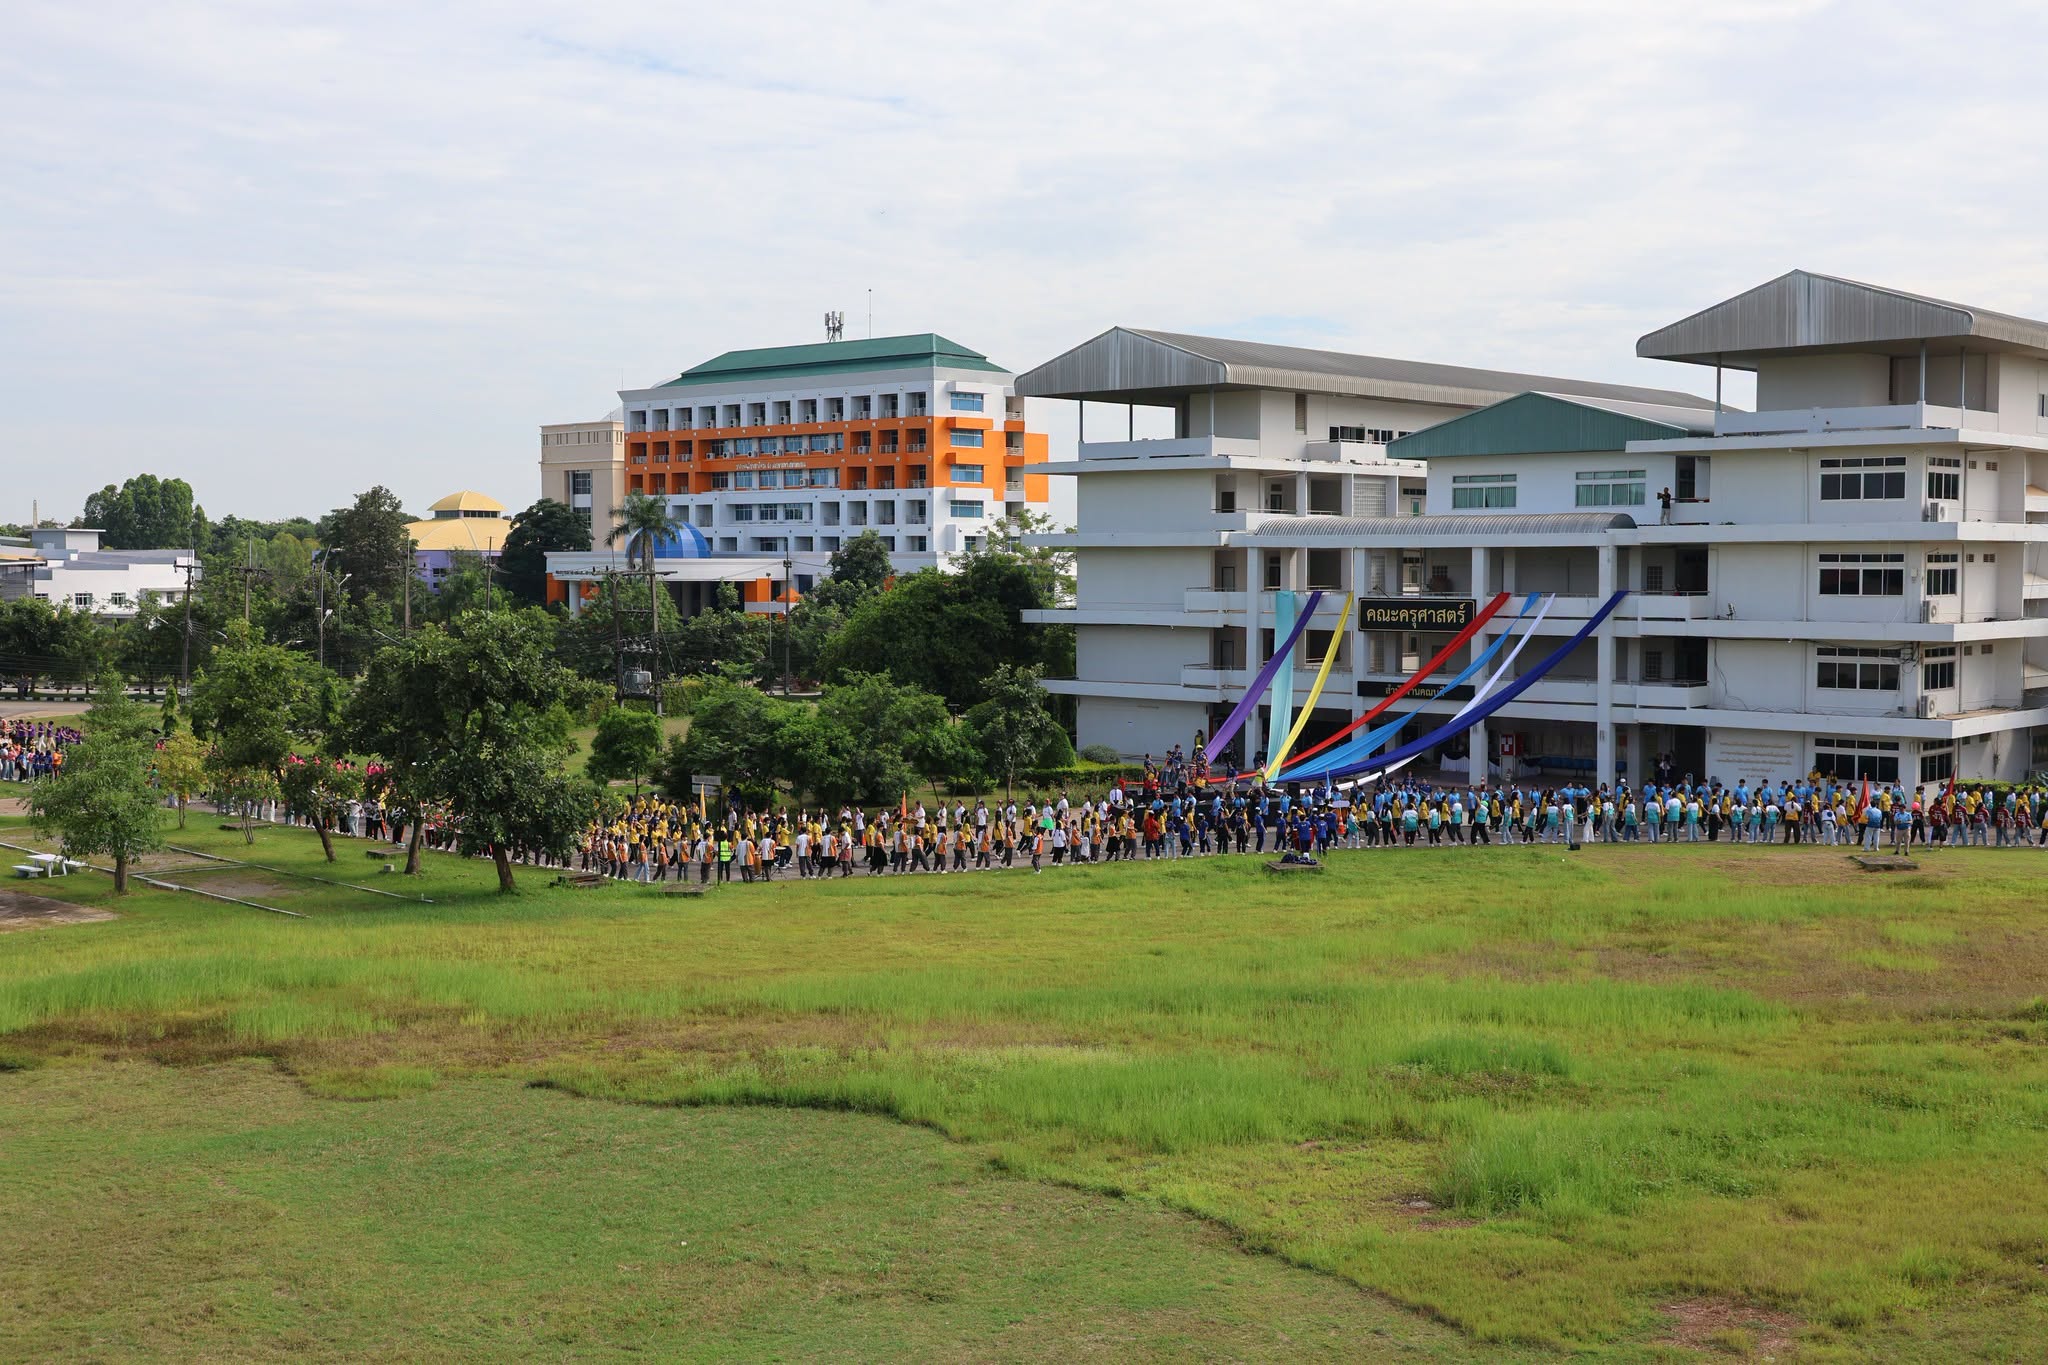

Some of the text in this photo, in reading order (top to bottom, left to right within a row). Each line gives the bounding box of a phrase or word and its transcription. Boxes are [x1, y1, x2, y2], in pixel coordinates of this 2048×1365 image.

[1367, 603, 1466, 629] คณะครุศาสตร์
